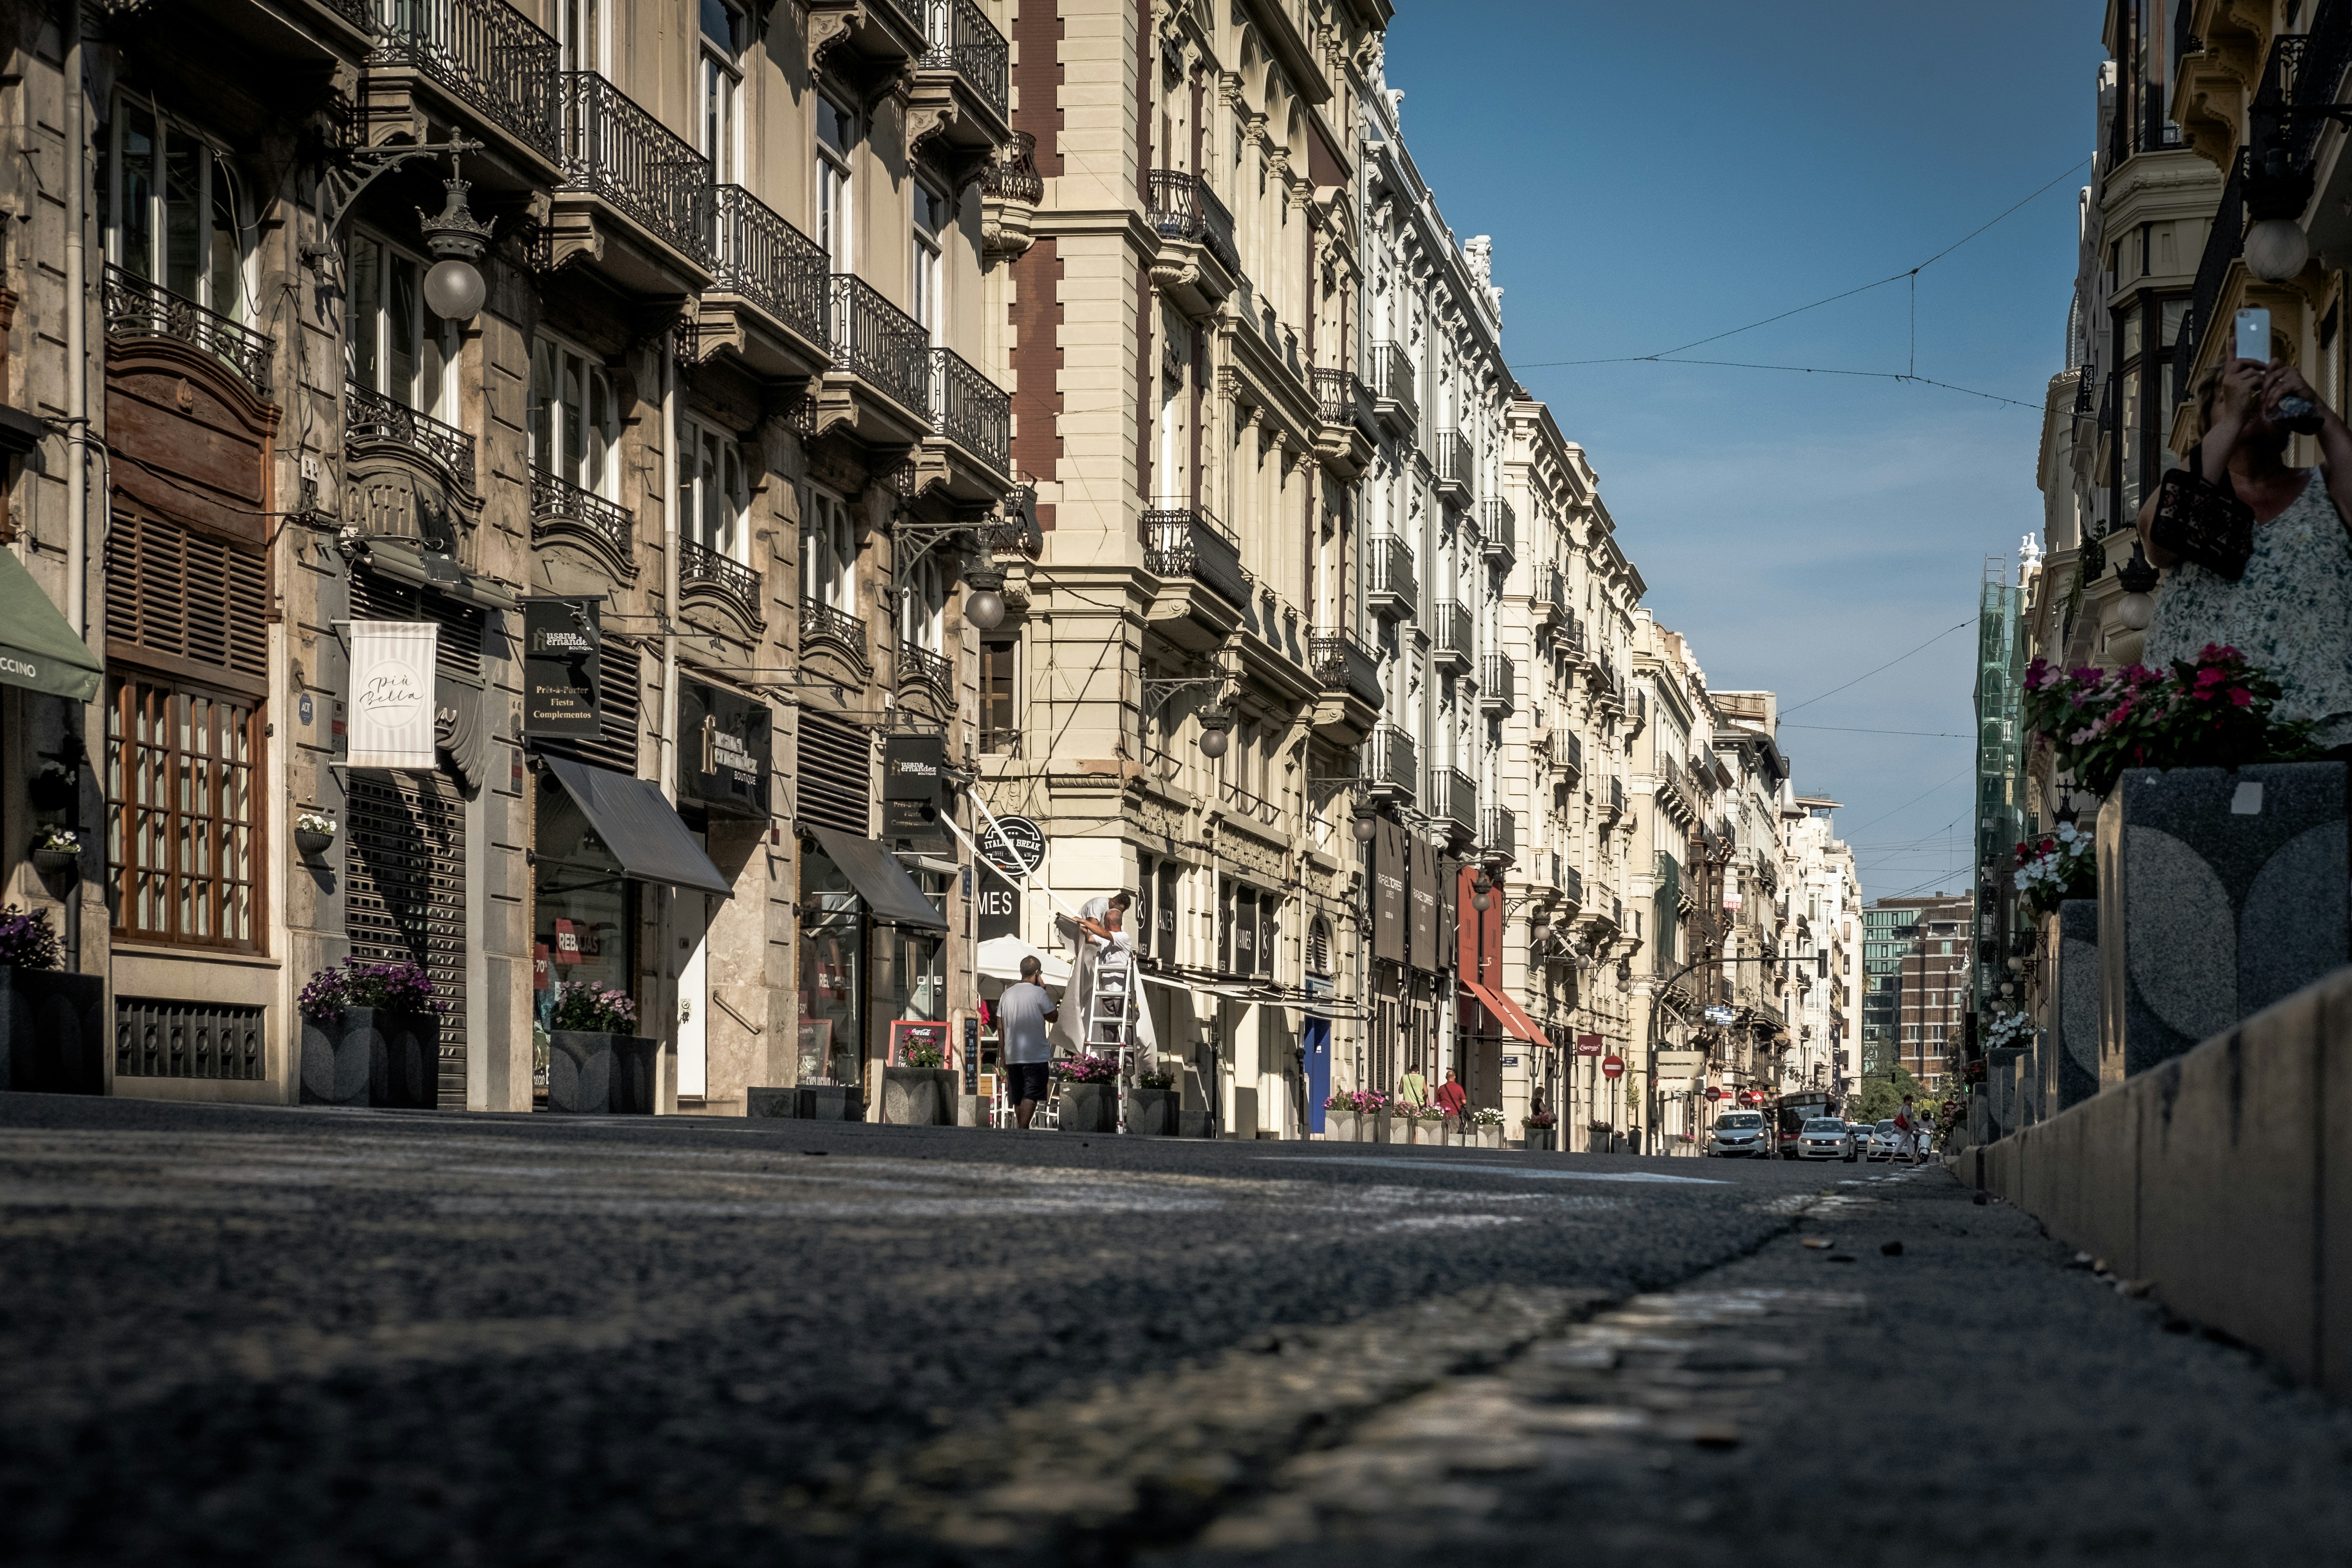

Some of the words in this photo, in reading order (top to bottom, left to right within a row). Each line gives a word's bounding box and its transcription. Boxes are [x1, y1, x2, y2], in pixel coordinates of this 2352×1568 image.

[0, 657, 36, 677] CCINO
[537, 686, 589, 694] Prêt-à-Porter
[359, 690, 425, 705] Bella
[301, 702, 311, 713] ADT
[533, 710, 591, 720] Complementos
[735, 771, 756, 785] BOUTIQUE
[1016, 839, 1041, 851] BREAK
[978, 891, 1012, 915] MES
[559, 932, 599, 953] REBAJAS
